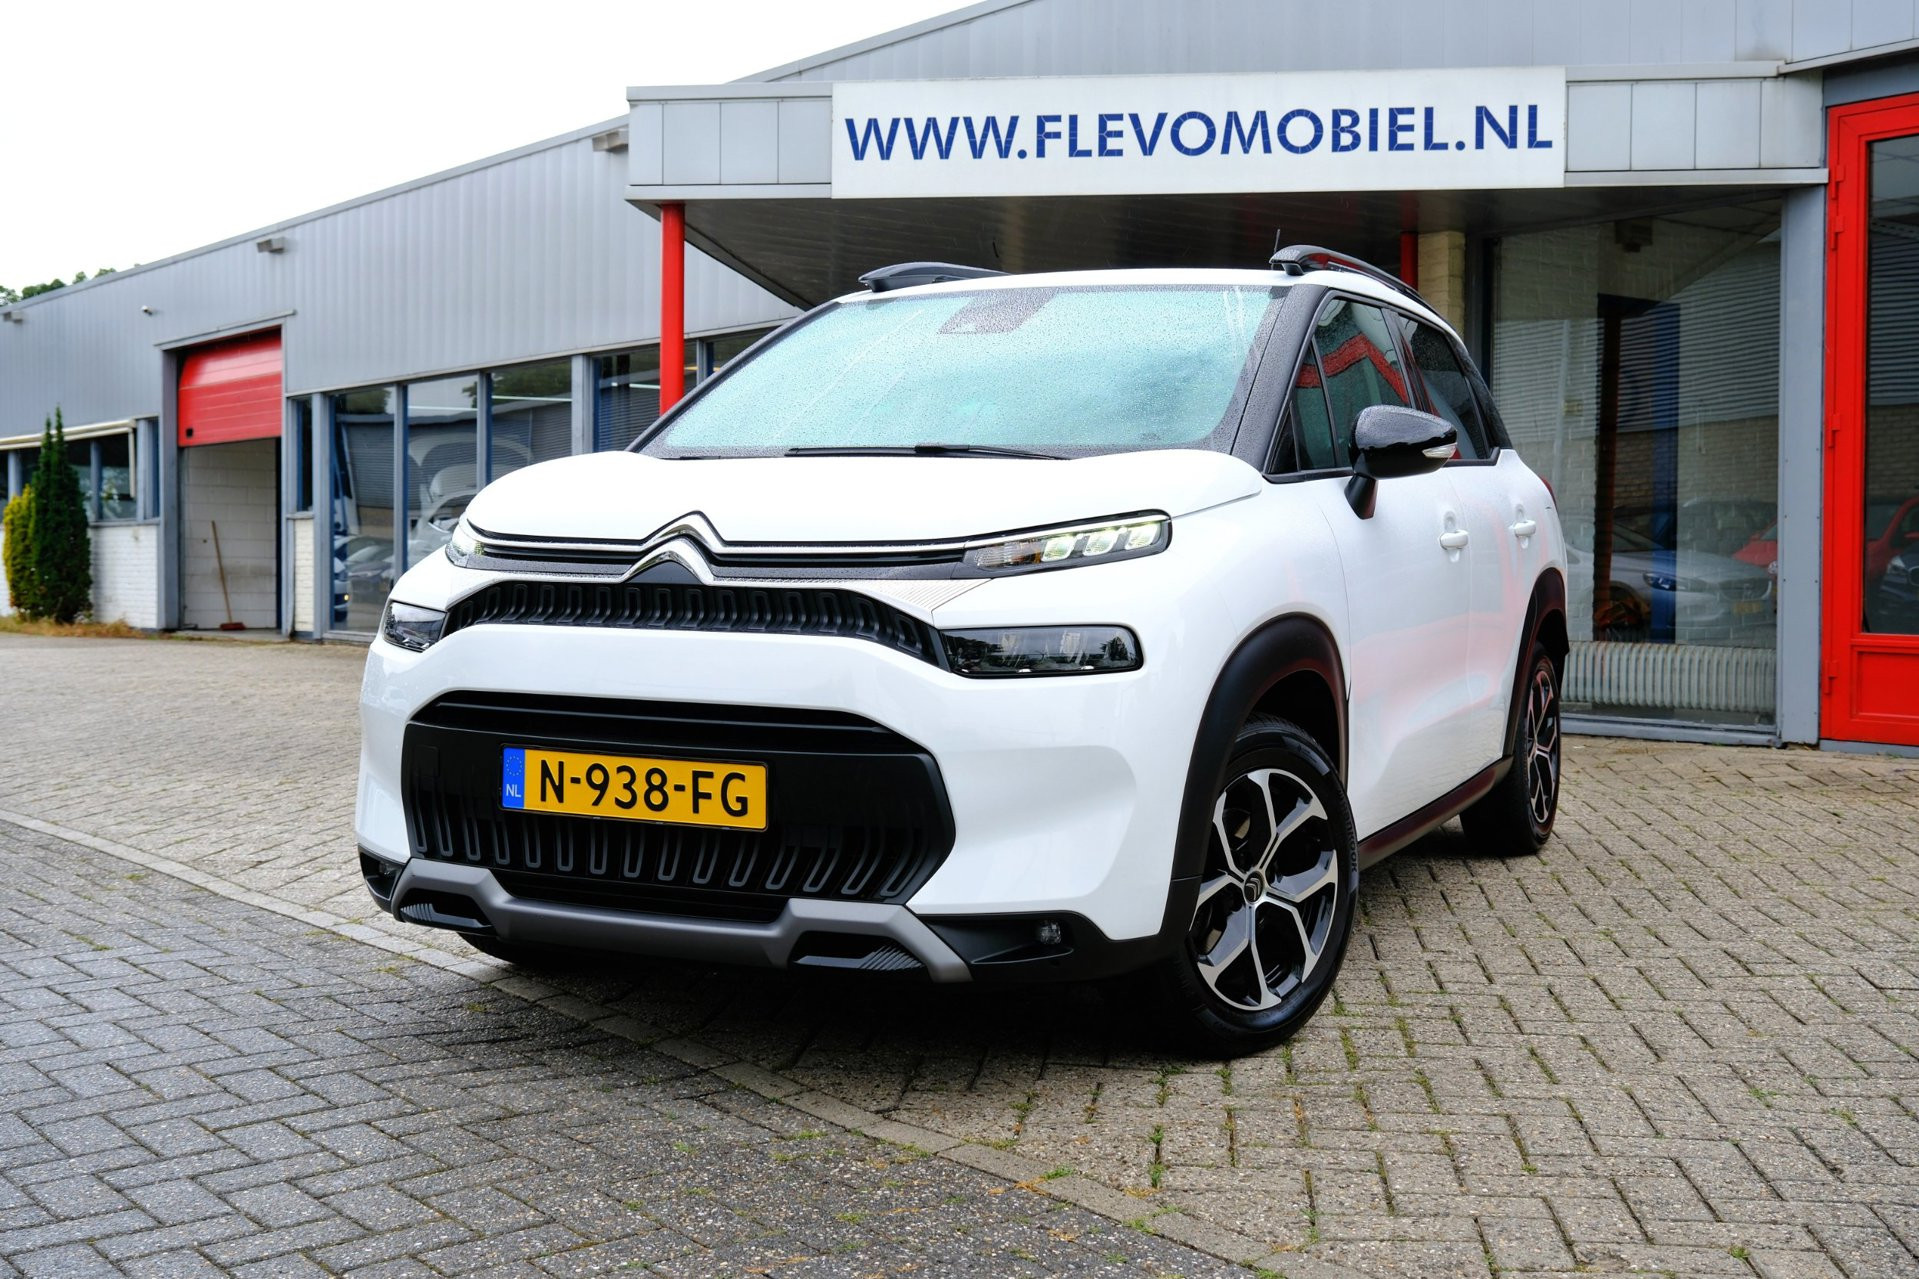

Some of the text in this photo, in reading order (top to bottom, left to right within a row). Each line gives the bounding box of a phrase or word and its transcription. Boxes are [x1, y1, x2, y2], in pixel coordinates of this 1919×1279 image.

[845, 104, 1553, 161] WWW.FLEVOMOBIEL.NL
[505, 783, 521, 798] NL
[540, 759, 749, 817] N-938-FG
